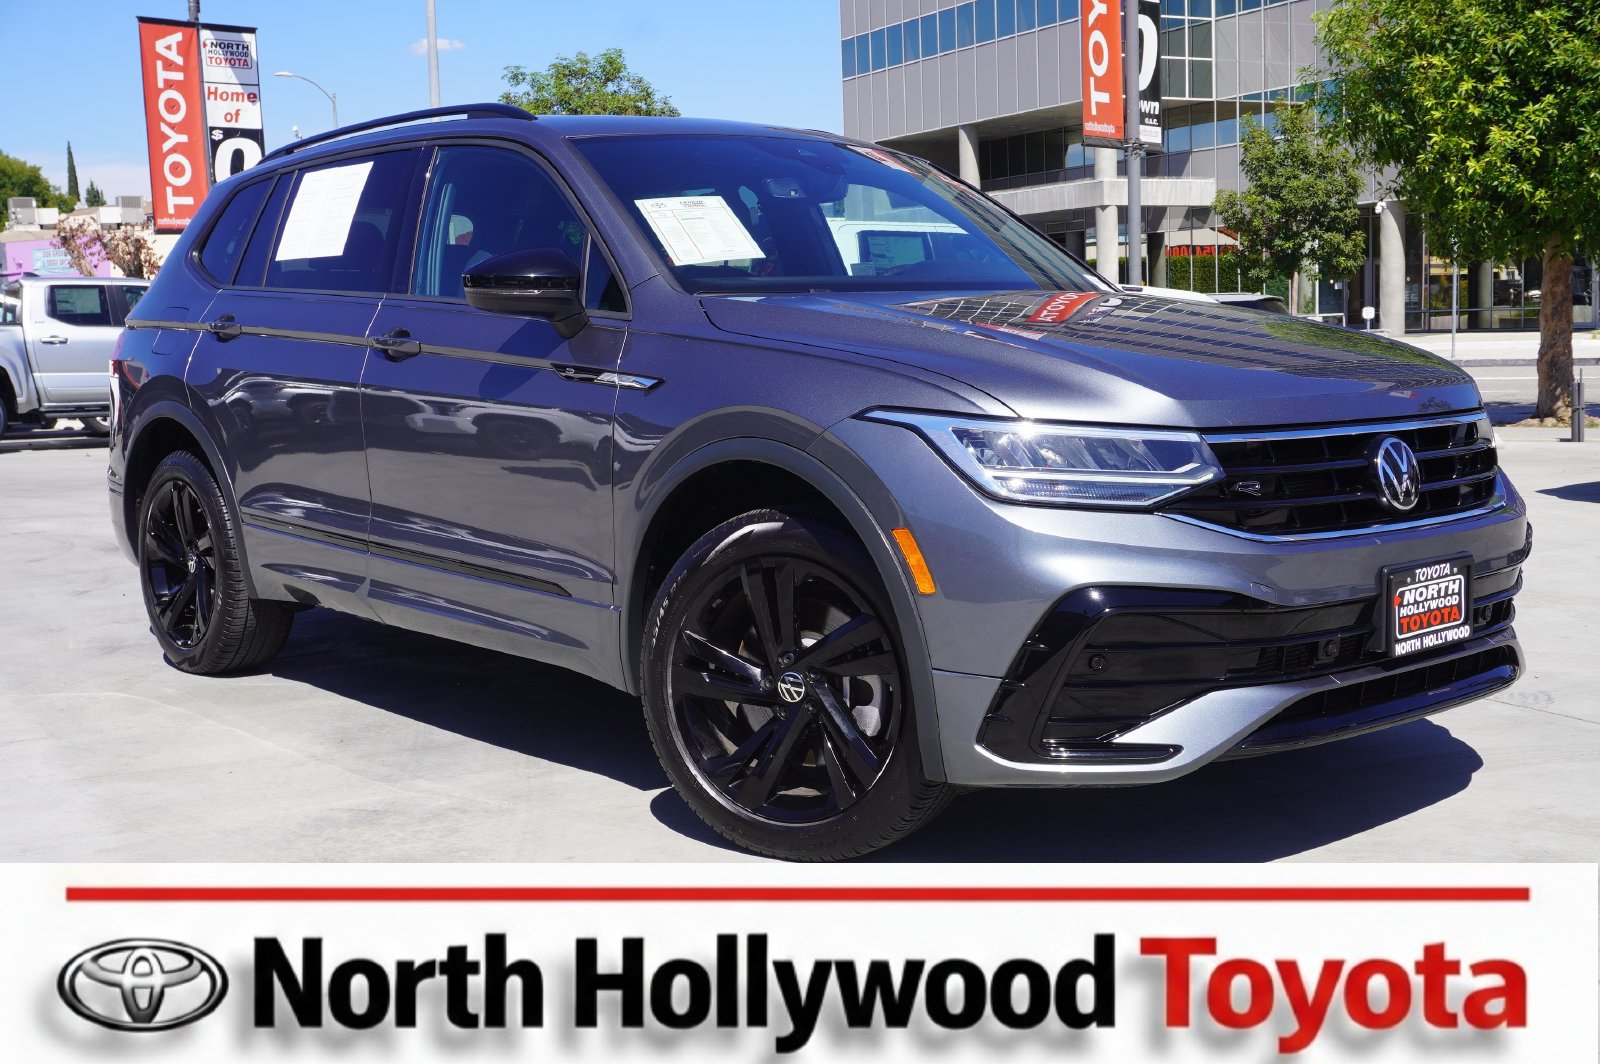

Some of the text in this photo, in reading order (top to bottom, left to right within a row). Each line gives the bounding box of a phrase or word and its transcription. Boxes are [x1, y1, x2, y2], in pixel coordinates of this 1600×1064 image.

[208, 49, 249, 58] HOLLYWOOD
[210, 41, 250, 51] NORTH
[208, 56, 249, 67] TOYOTA
[207, 86, 257, 103] Home
[155, 31, 194, 214] TOYOTA
[224, 109, 241, 123] of
[1415, 563, 1450, 582] TOYOTA
[1403, 580, 1460, 605] NORTH
[1400, 595, 1459, 617] HOLLYWOOD
[1400, 606, 1460, 634] TOYOTA
[1395, 625, 1470, 656] NORTH HOLLYWOOD
